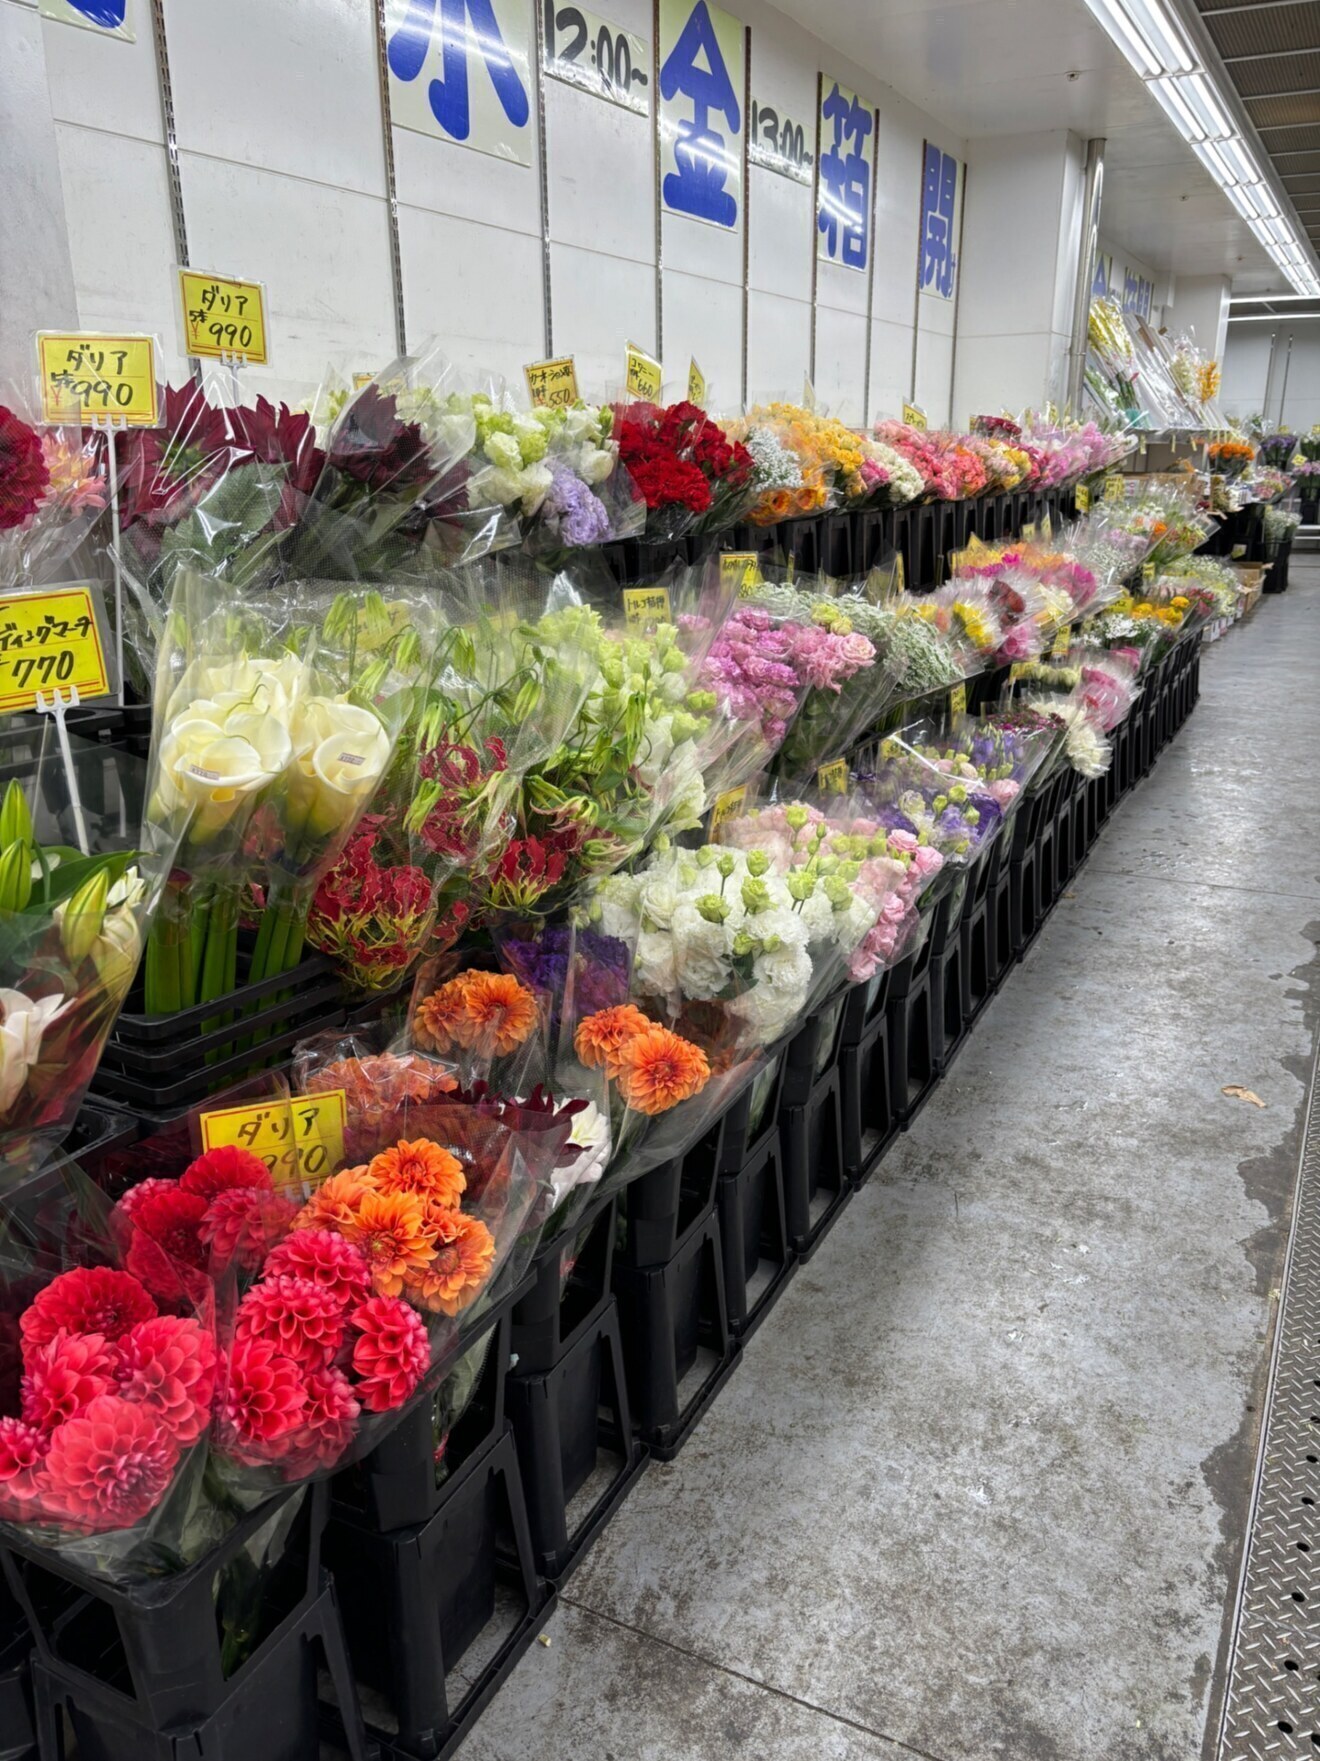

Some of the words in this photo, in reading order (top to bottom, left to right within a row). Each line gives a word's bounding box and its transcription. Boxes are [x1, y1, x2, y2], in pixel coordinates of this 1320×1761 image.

[660, 0, 741, 228] 金
[201, 285, 249, 316] ダリア
[66, 344, 128, 375] ダリア
[12, 650, 74, 688] 770
[237, 1107, 320, 1146] ダリア
